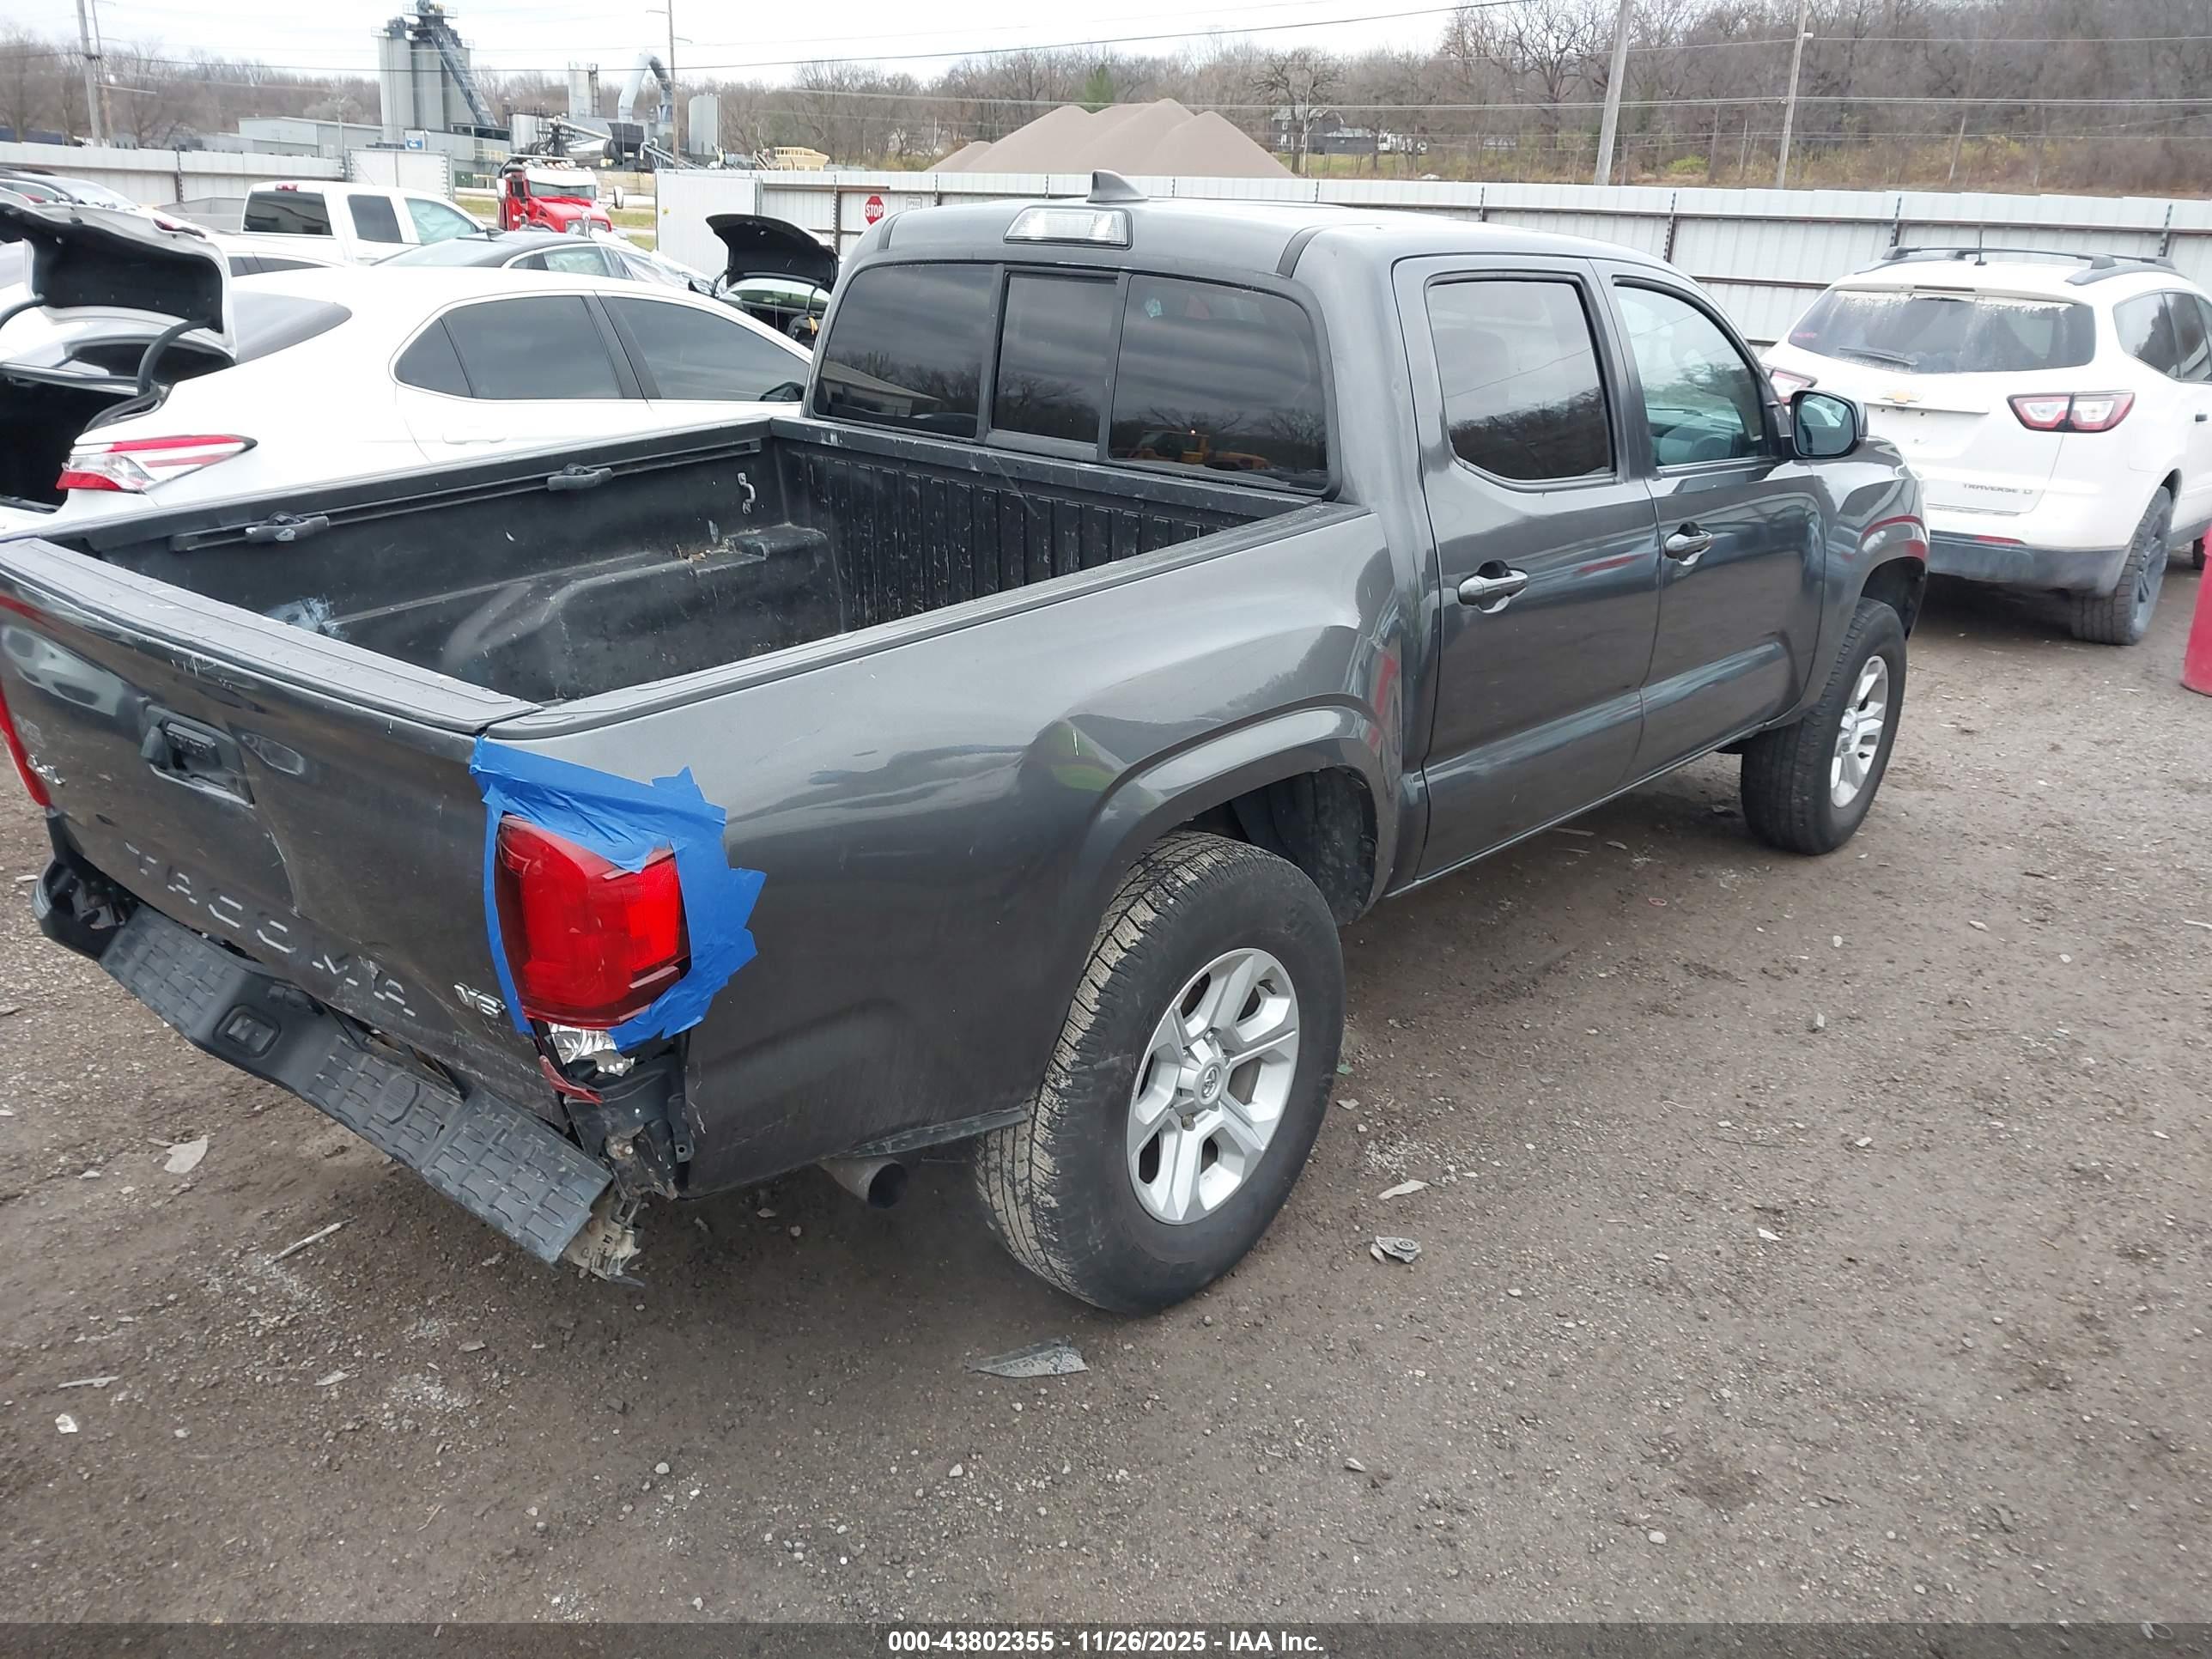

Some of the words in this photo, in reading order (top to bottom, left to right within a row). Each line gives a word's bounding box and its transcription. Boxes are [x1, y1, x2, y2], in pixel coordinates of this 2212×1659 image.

[866, 204, 884, 217] STOP
[1962, 483, 2019, 494] TRAVERSE
[125, 831, 416, 1018] TACOMA
[453, 981, 507, 1018] V6
